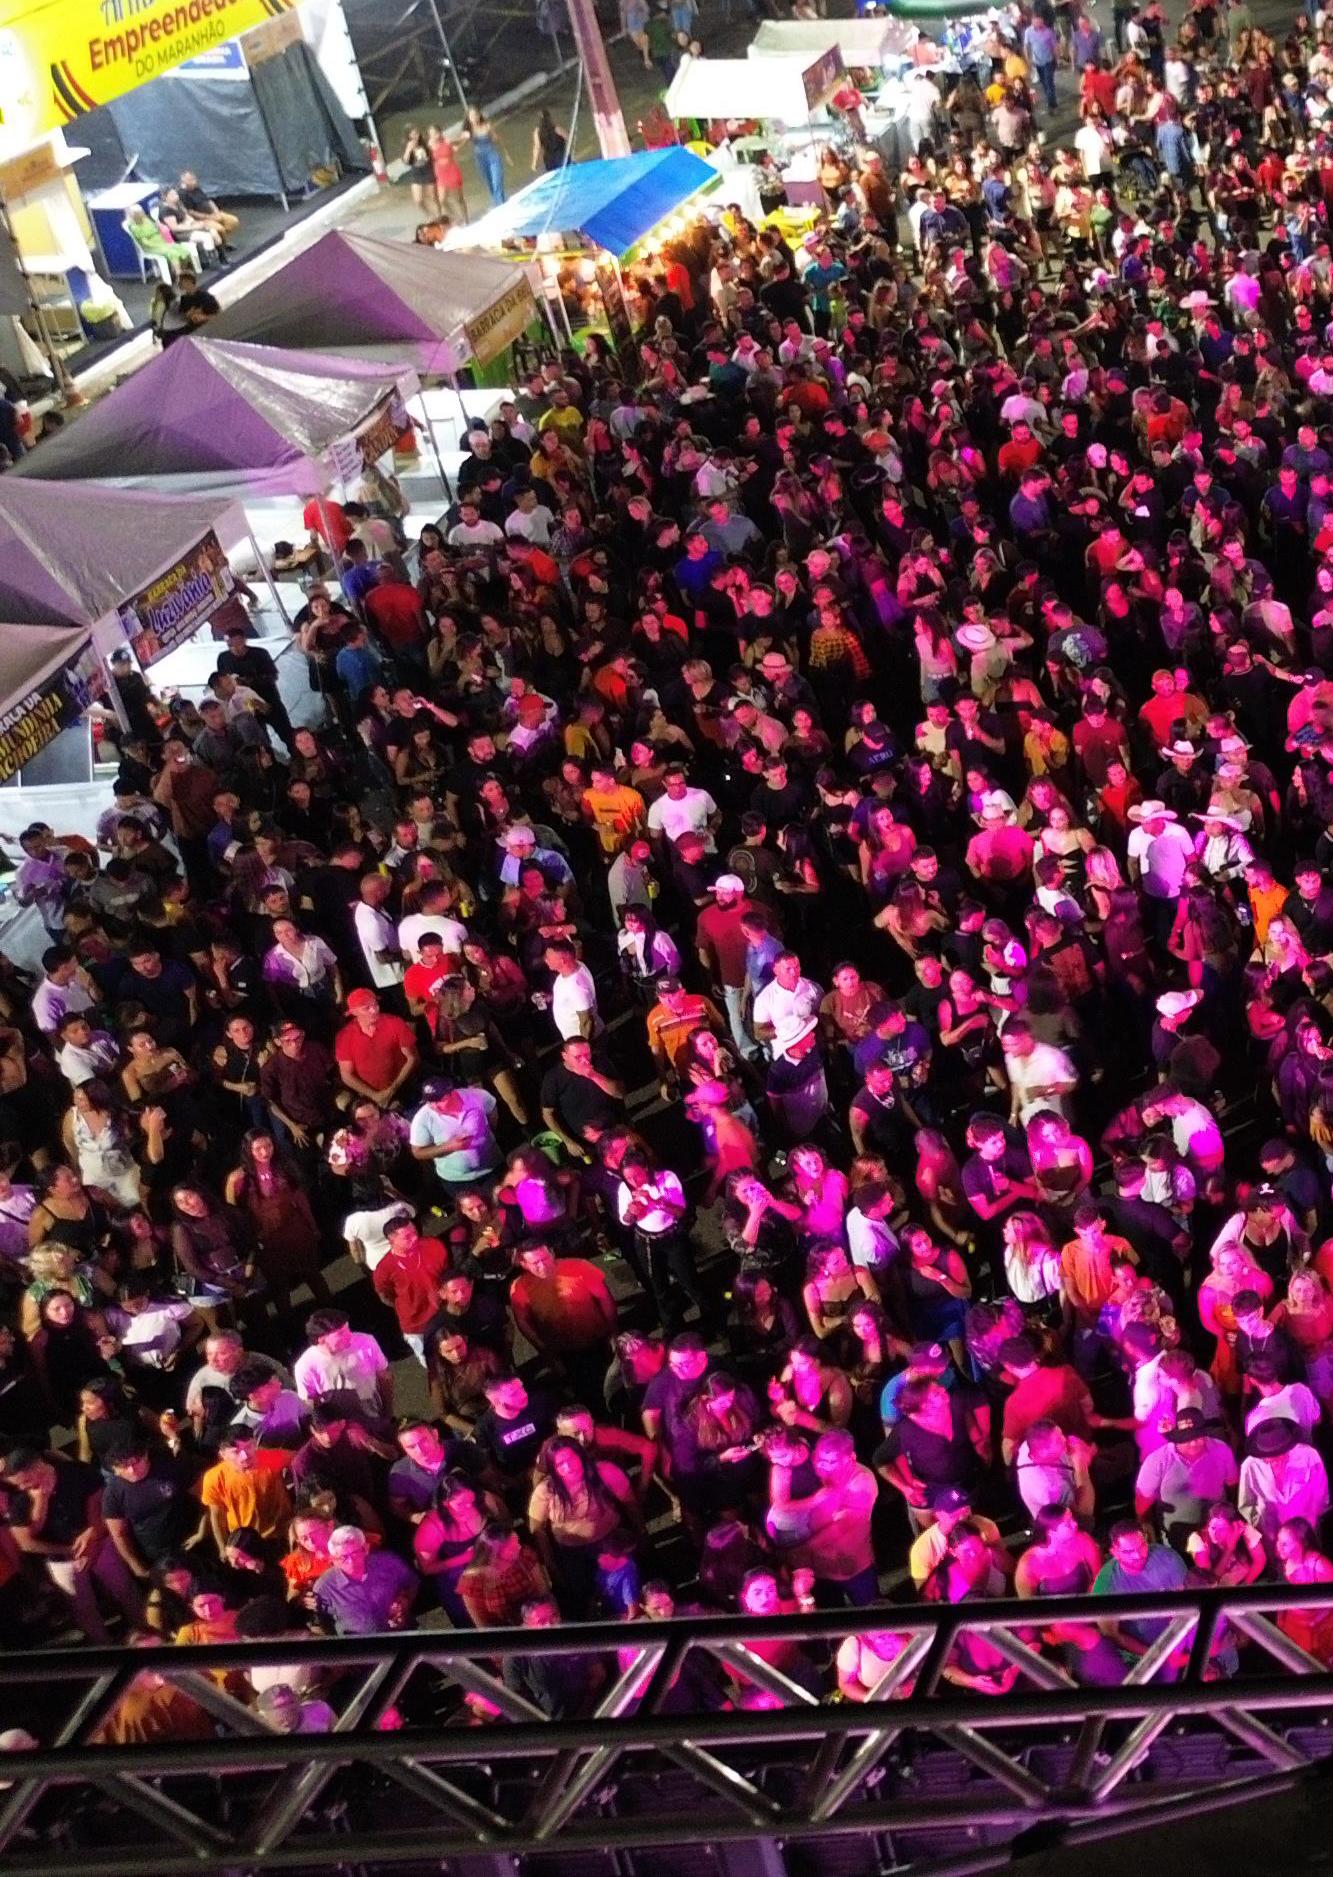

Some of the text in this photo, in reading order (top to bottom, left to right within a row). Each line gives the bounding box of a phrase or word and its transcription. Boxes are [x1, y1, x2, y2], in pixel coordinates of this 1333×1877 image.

[88, 0, 238, 72] Empreende
[135, 54, 155, 78] DO
[157, 19, 226, 69] MARANHÃO
